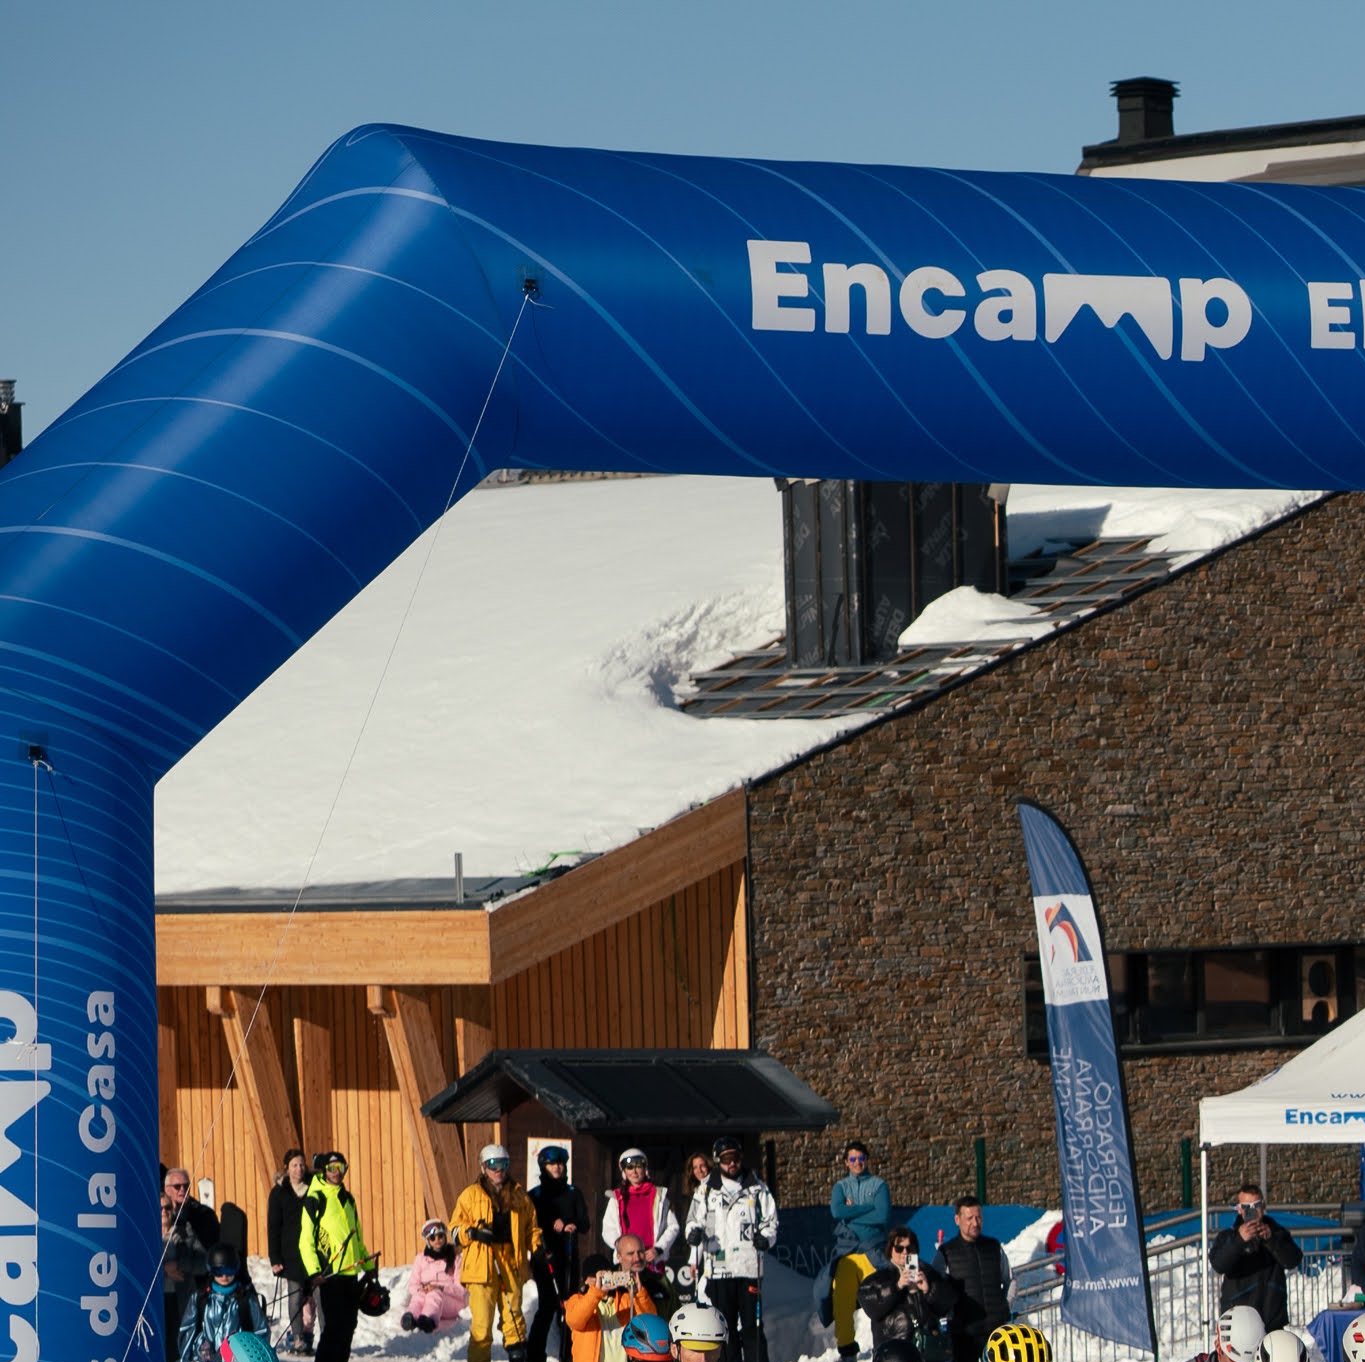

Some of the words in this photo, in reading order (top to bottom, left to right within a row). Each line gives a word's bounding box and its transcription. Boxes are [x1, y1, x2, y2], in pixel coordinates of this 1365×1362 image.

[747, 240, 1252, 362] Encamp
[79, 990, 117, 1153] Casa
[78, 1172, 118, 1228] la
[80, 1250, 119, 1337] de
